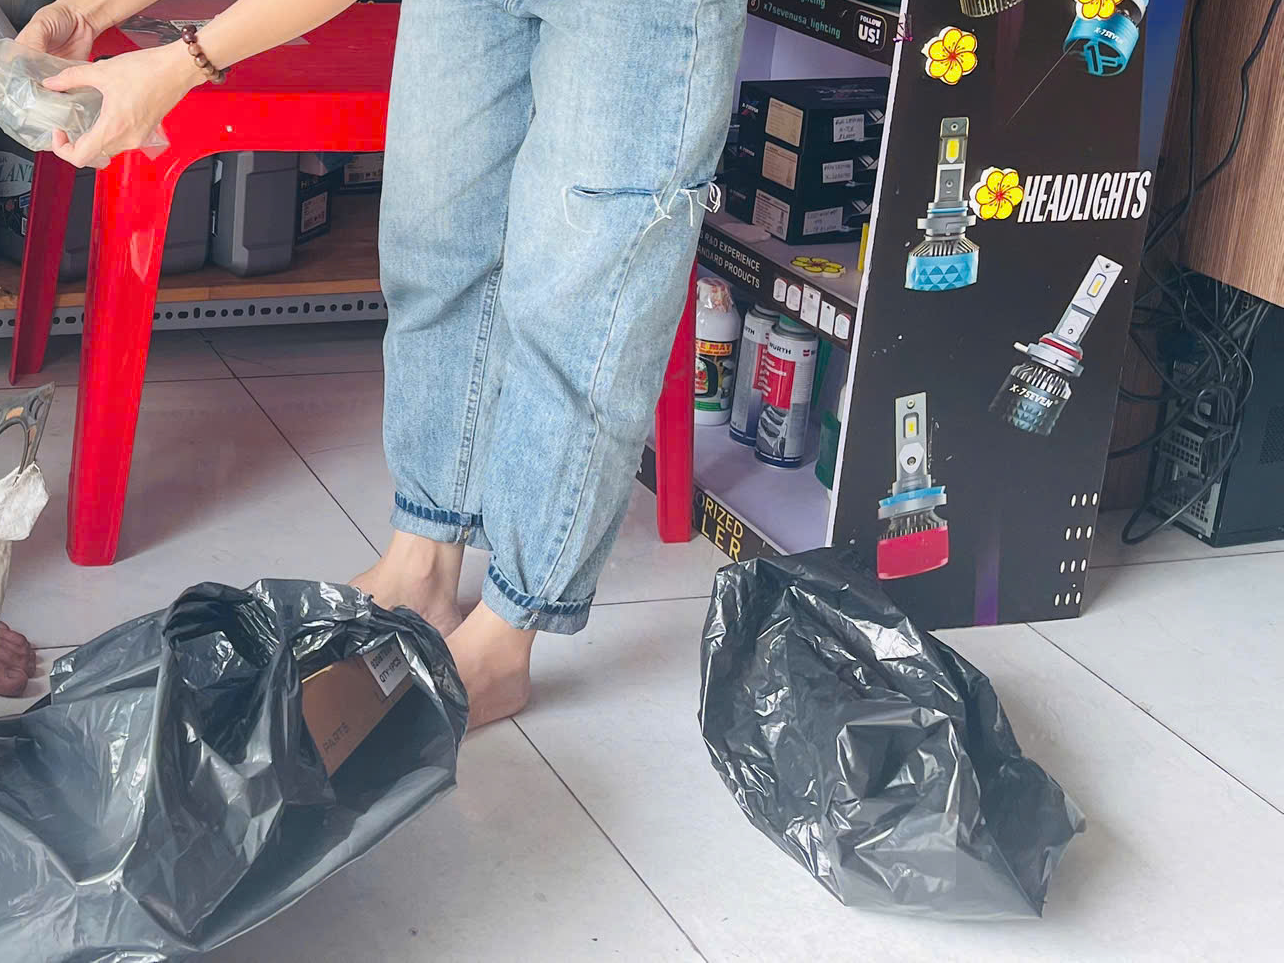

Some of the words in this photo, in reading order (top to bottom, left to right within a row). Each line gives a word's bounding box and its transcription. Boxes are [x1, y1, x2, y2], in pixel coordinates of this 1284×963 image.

[763, 3, 842, 40] x7sevenusa_lighting
[858, 24, 881, 45] US!
[859, 14, 882, 28] FOLLOW
[1017, 170, 1152, 223] HEADLIGHTS
[719, 241, 760, 273] EXPERIENCE
[724, 262, 760, 289] PRODUCTS
